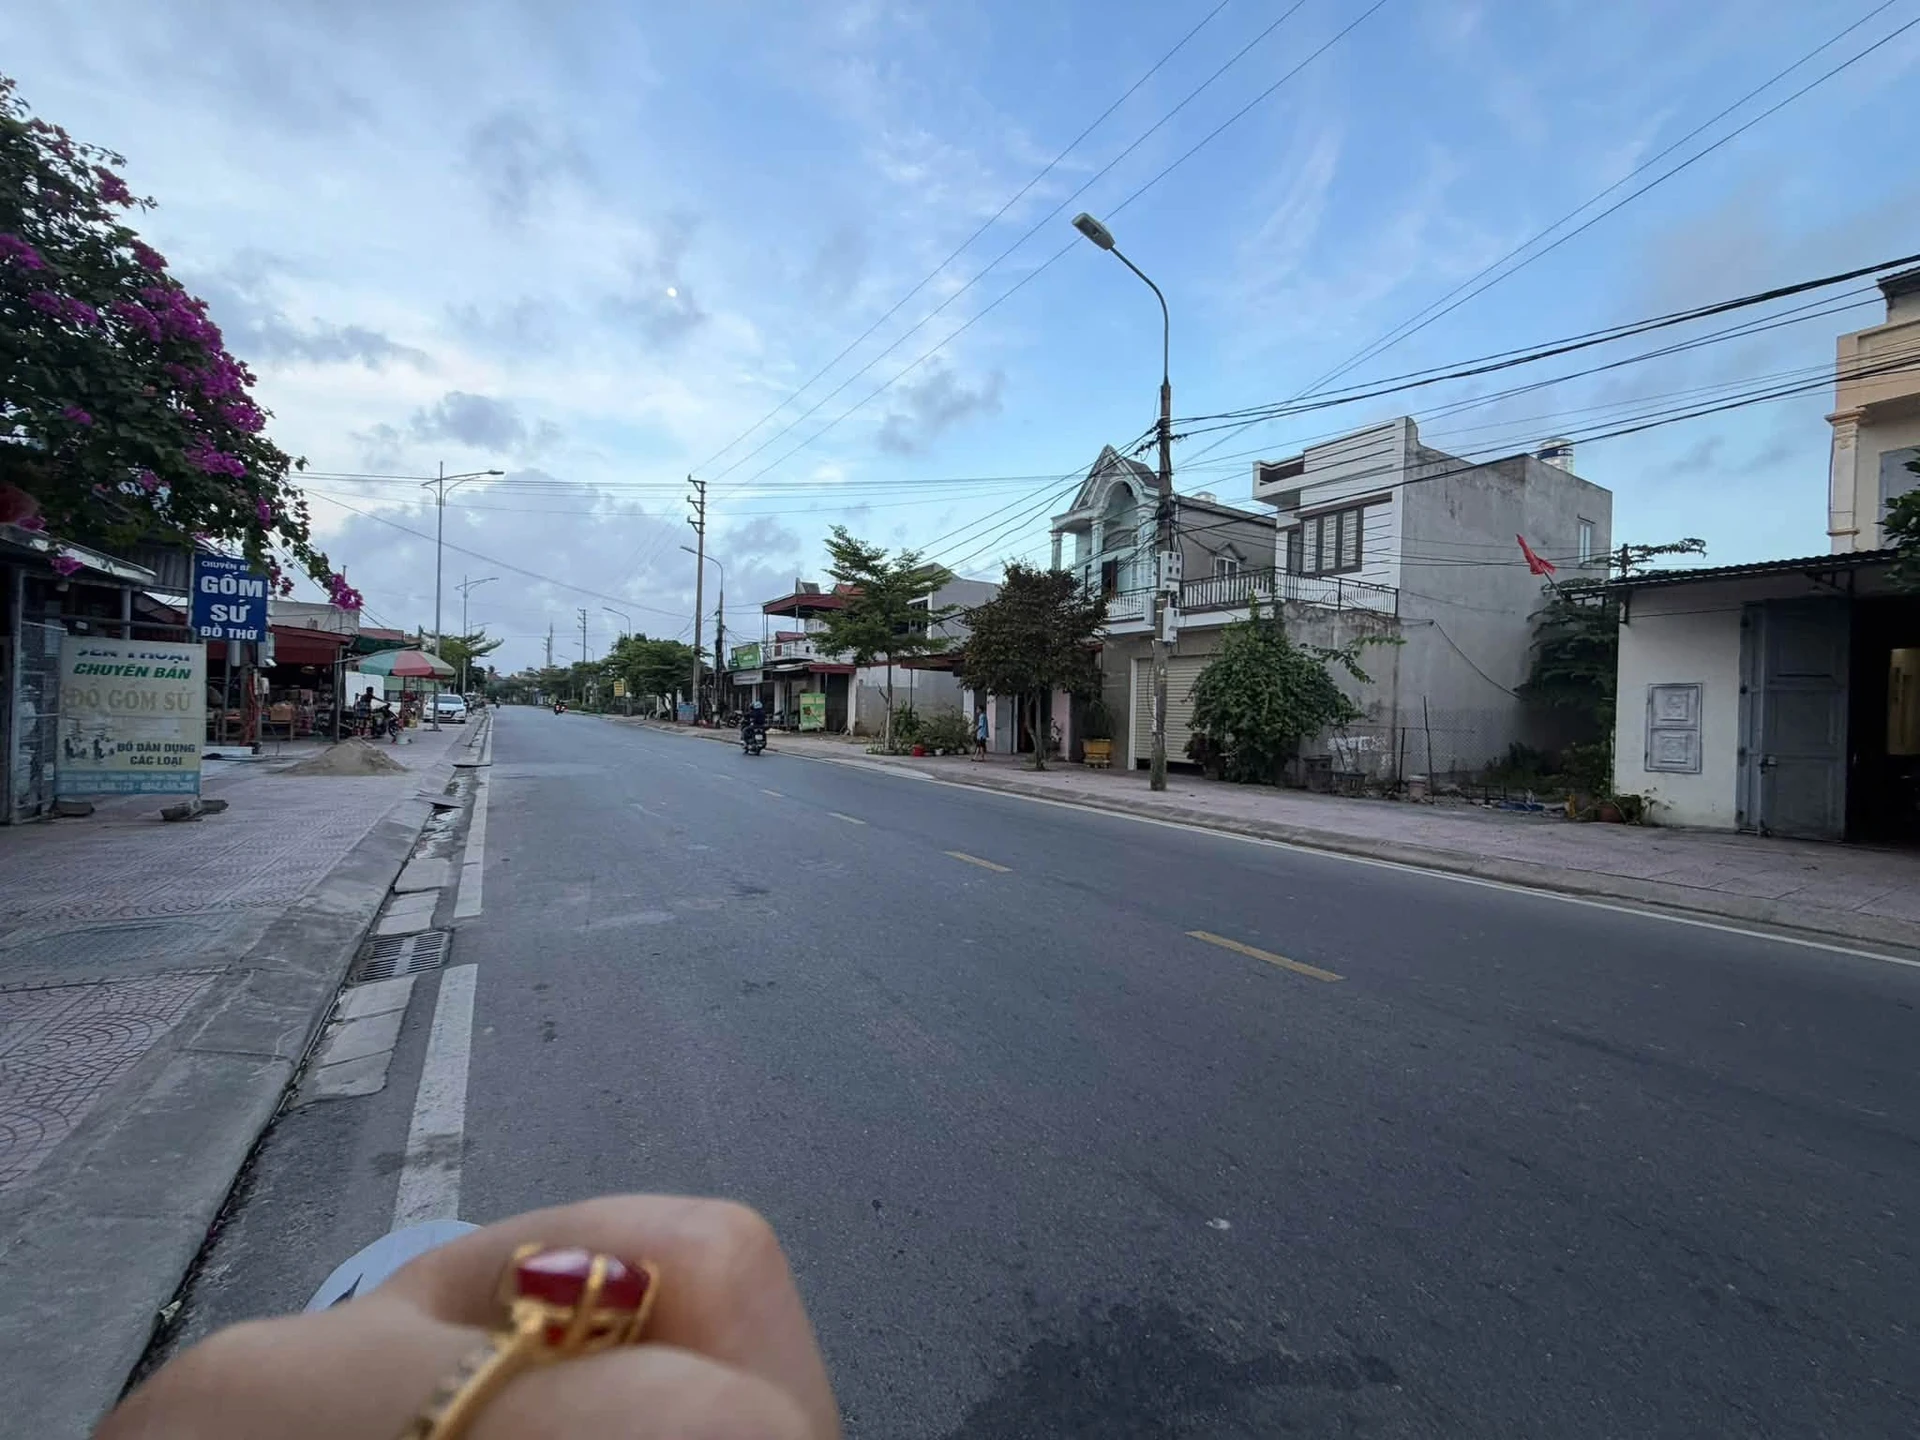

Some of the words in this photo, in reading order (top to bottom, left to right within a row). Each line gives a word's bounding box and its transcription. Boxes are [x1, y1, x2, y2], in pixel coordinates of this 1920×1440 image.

[200, 571, 264, 598] GỐM
[210, 599, 252, 623] SỨ
[200, 622, 223, 637] ĐỒ
[227, 626, 258, 640] THỜ
[73, 661, 150, 678] CHUYÊN
[154, 665, 192, 680] BÁN
[108, 681, 158, 711] GỐM
[164, 743, 196, 755] DỤNG
[130, 754, 154, 765] CÁC
[157, 756, 183, 767] LOẠI
